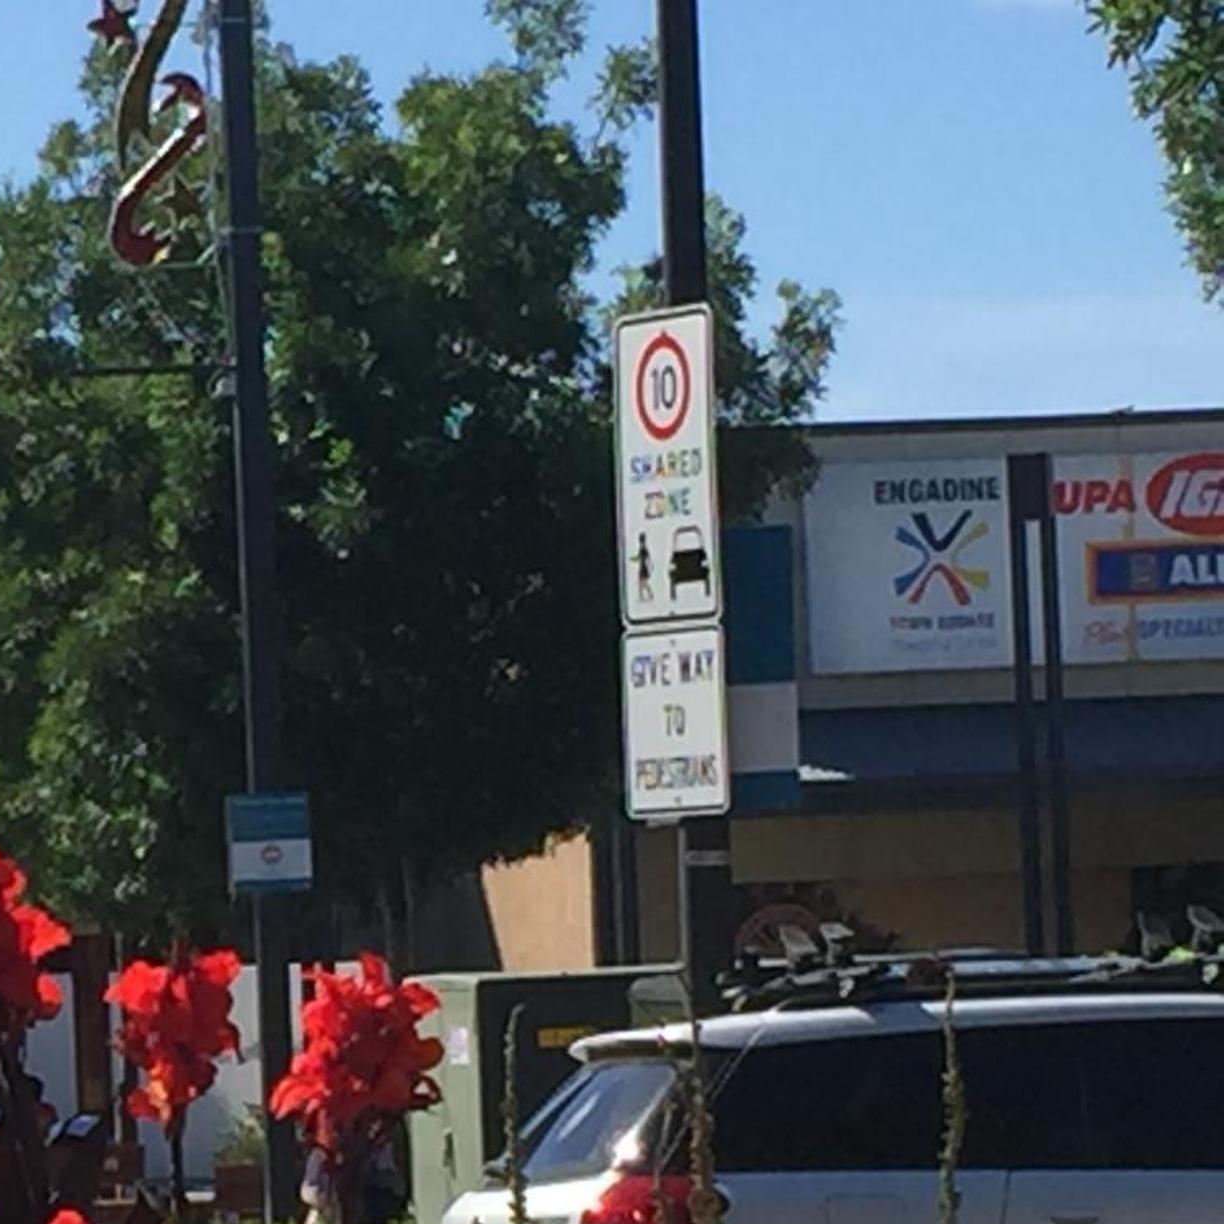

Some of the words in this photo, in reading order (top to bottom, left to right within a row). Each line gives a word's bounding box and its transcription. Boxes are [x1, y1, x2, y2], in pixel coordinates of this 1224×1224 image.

[650, 364, 677, 411] 10
[630, 448, 702, 482] SHARED
[644, 487, 691, 519] ZONE
[873, 476, 1002, 504] ENGADINE
[1051, 479, 1136, 514] UPA
[1160, 467, 1224, 519] IG
[631, 653, 671, 688] GIVE
[678, 650, 715, 683] WAY
[664, 704, 686, 736] TO
